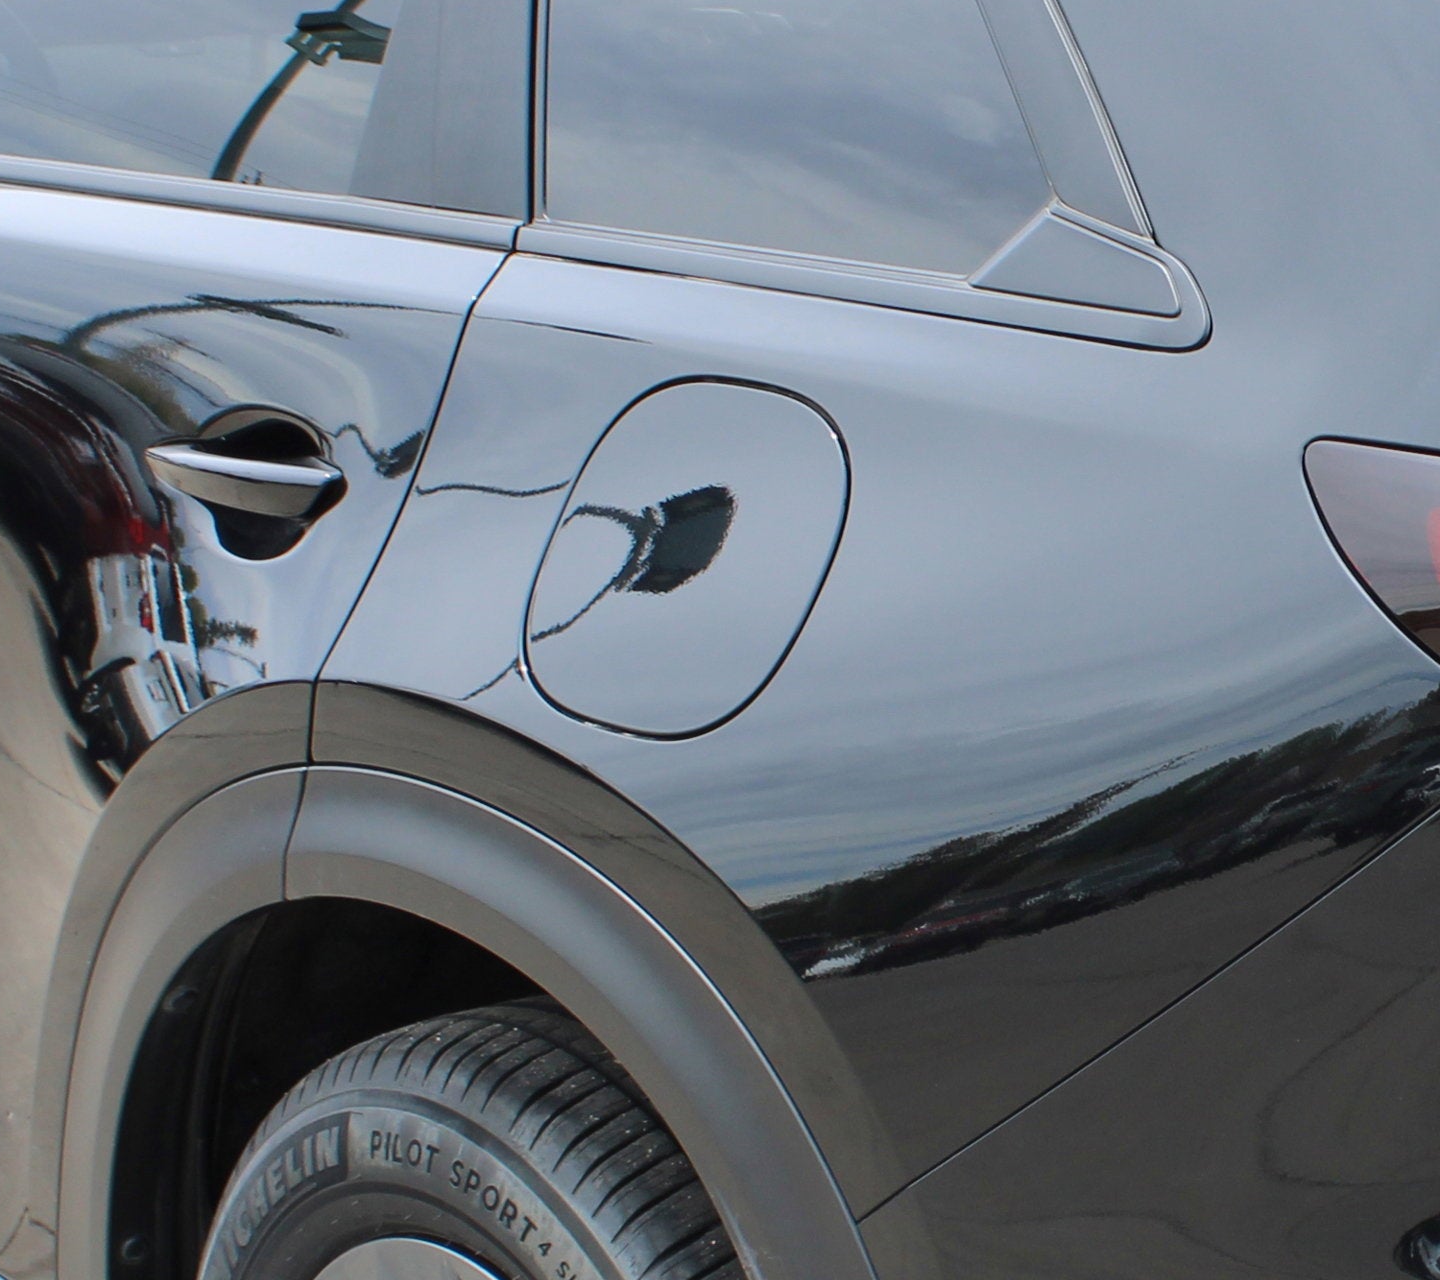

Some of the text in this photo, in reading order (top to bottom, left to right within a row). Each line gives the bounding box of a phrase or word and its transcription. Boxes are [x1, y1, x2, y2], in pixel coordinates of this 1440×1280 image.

[369, 1129, 441, 1174] PILOT
[448, 1159, 538, 1243] SPORT
[539, 1240, 554, 1258] 4
